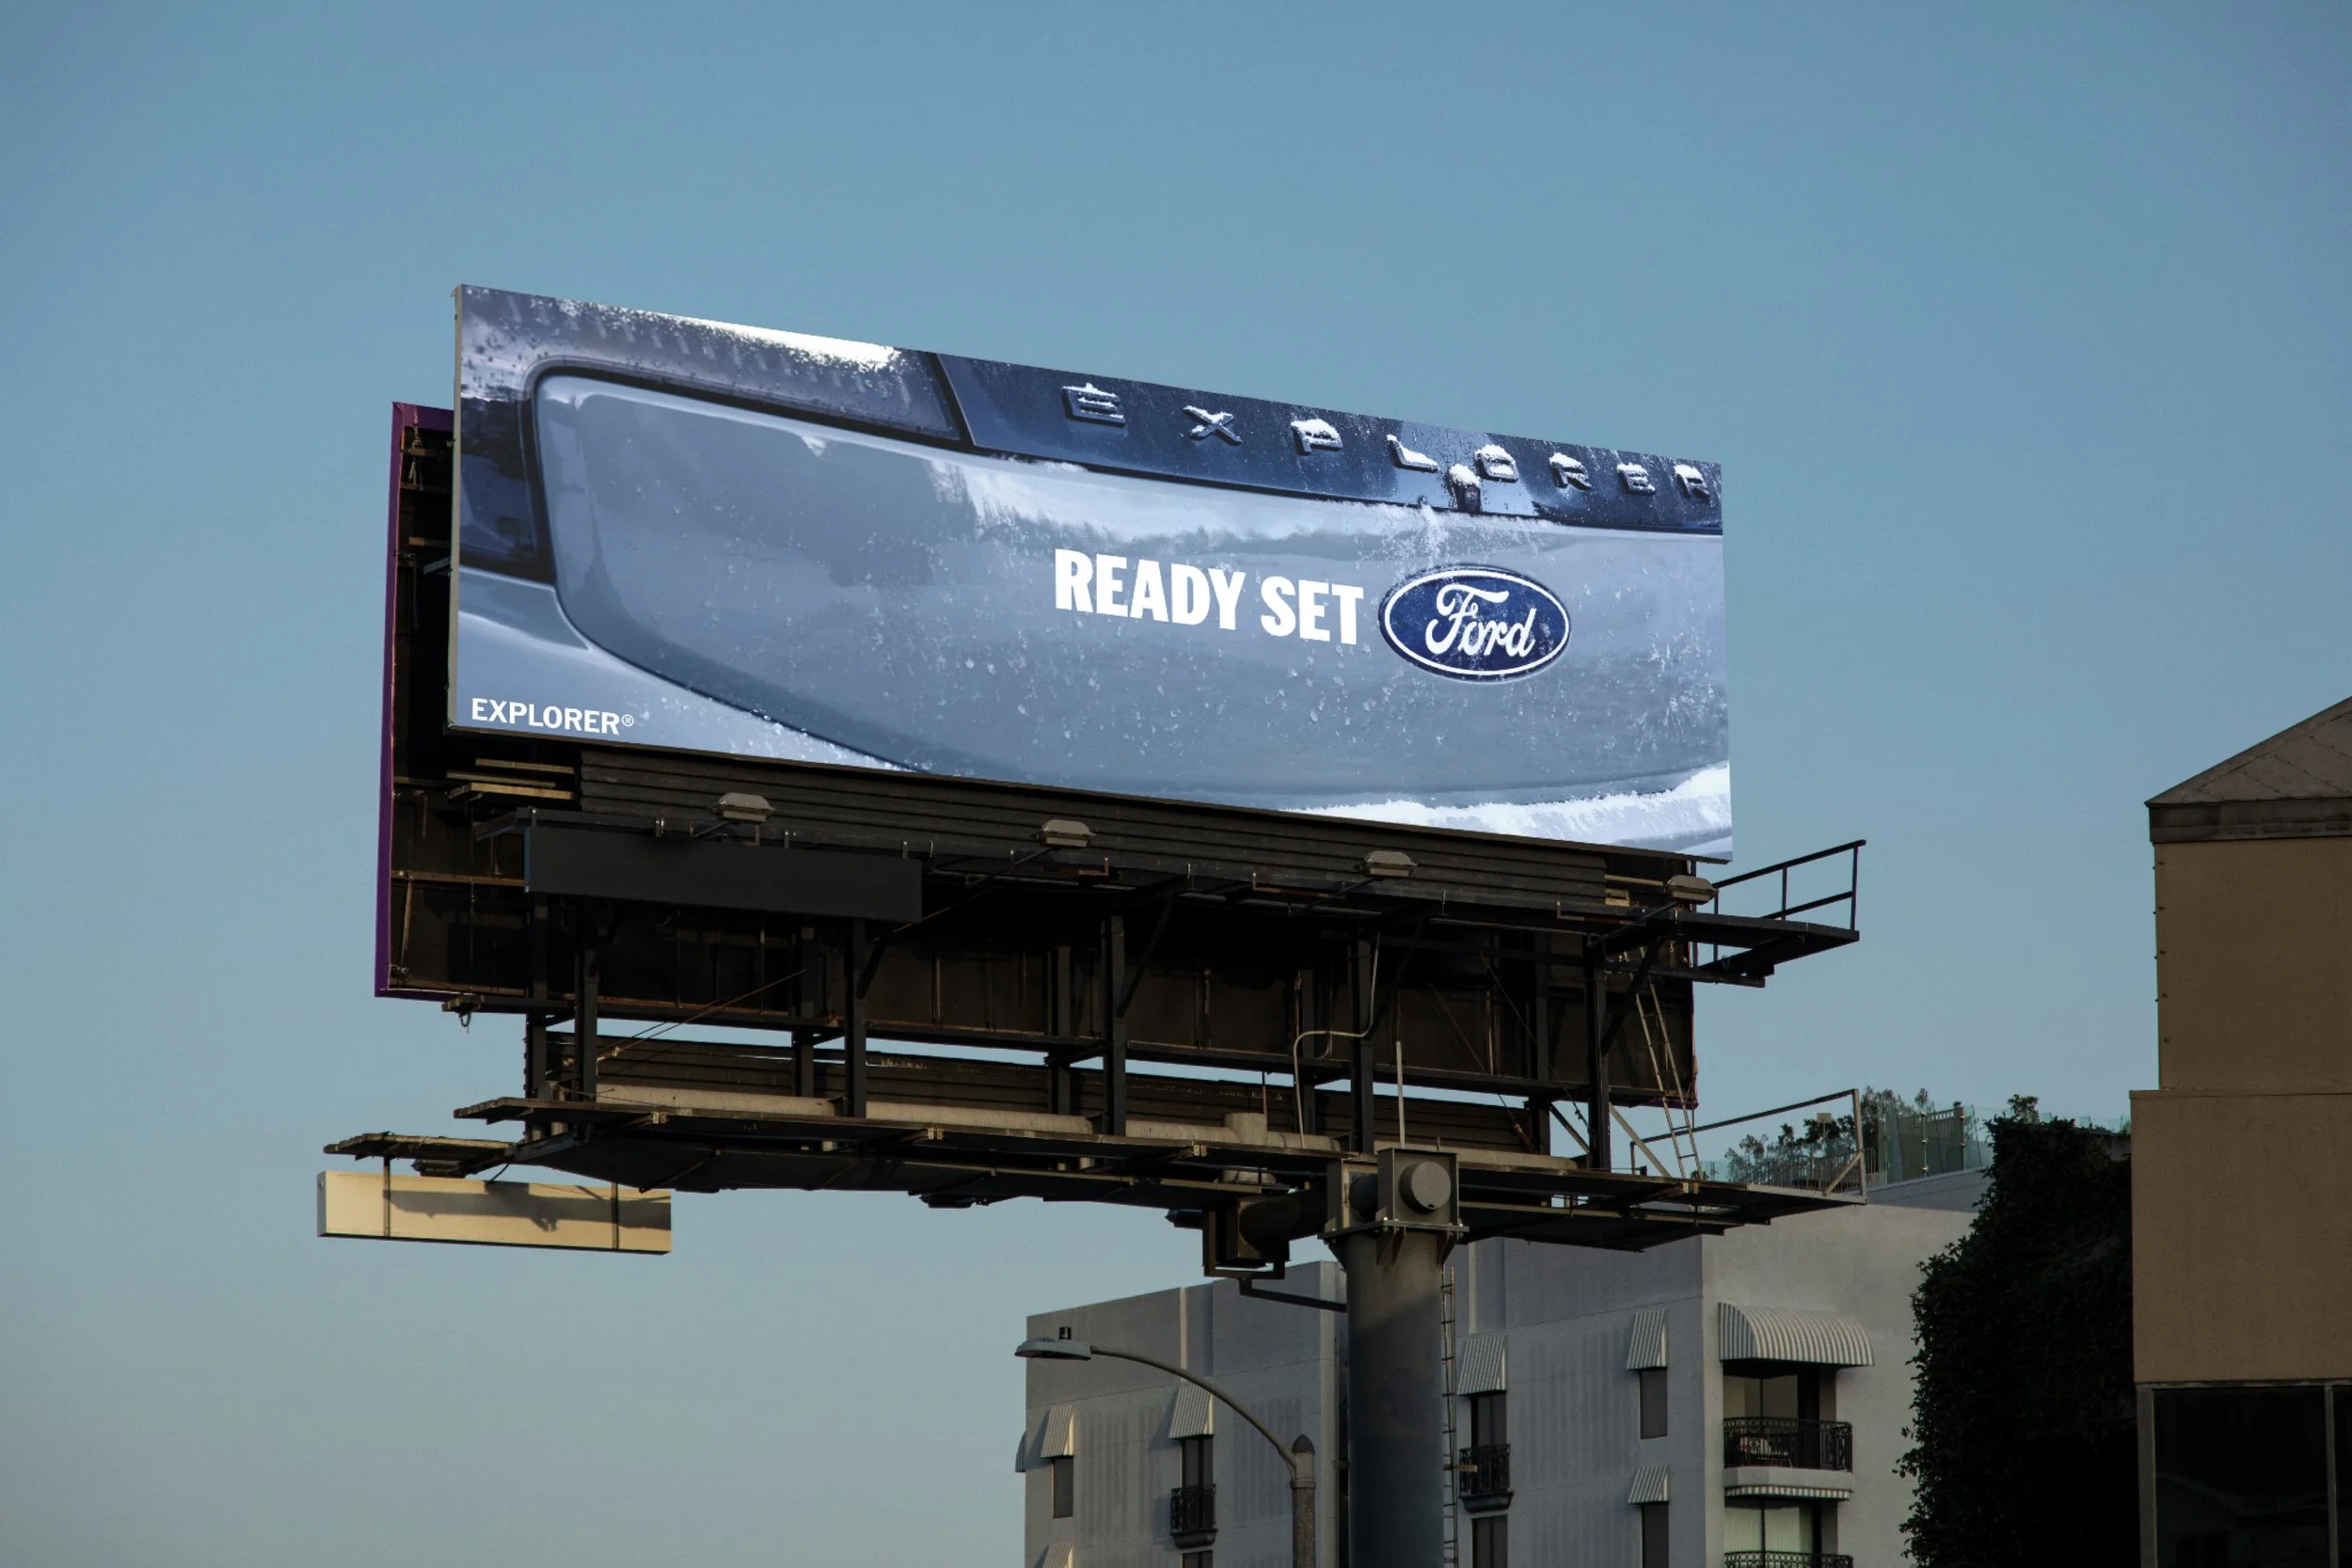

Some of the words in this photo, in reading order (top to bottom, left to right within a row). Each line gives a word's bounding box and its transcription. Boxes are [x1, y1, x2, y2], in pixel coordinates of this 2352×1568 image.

[1061, 382, 1710, 499] EXPLORER
[1055, 548, 1248, 631] READY
[1261, 576, 1364, 645] SET
[1424, 583, 1538, 658] Ford
